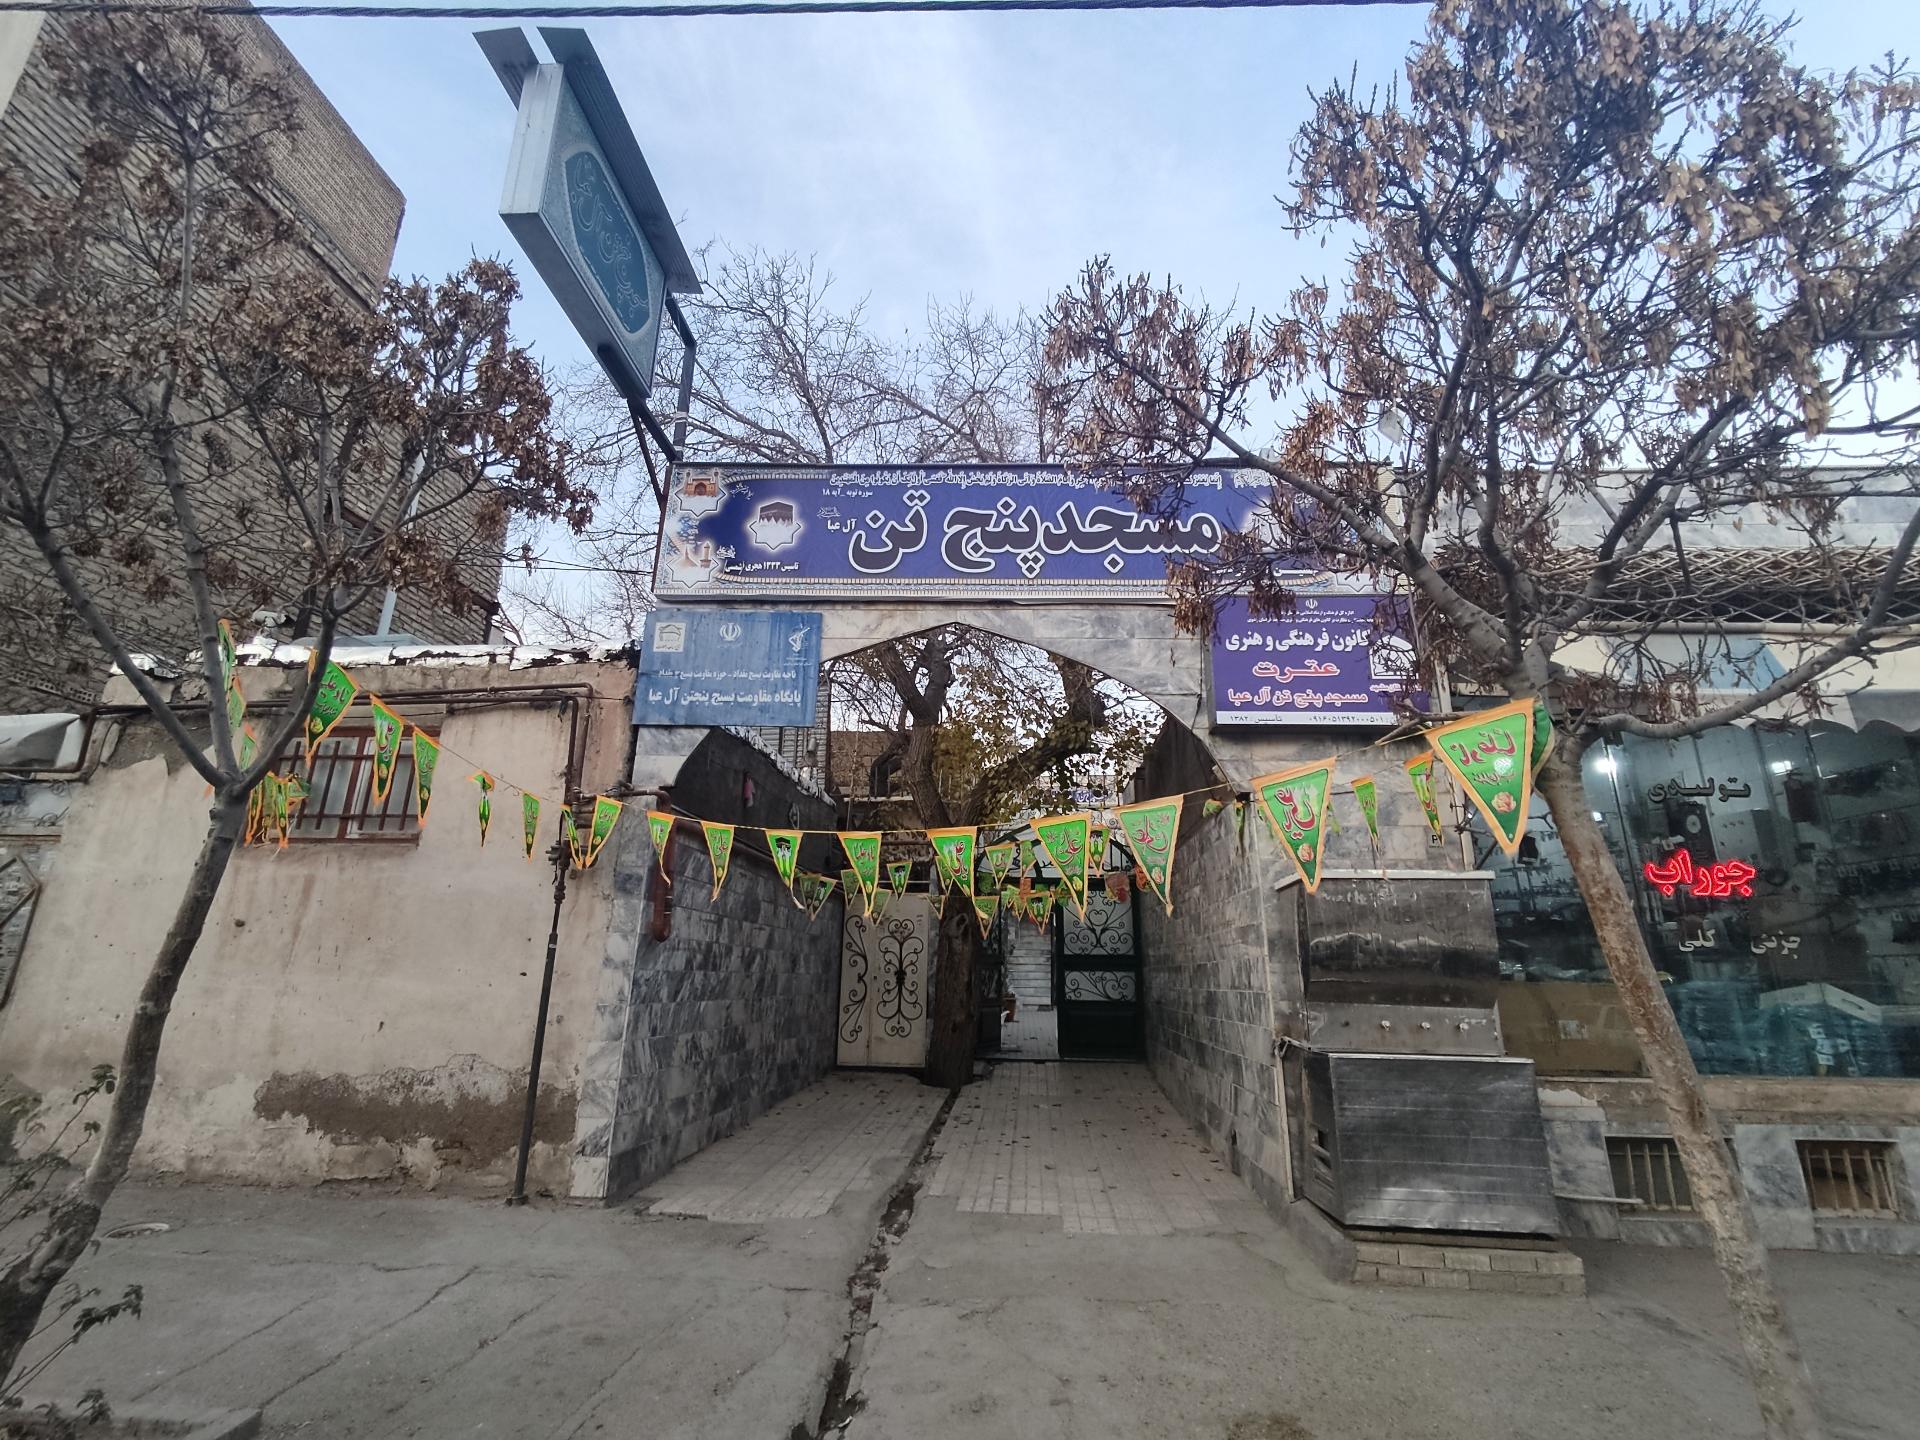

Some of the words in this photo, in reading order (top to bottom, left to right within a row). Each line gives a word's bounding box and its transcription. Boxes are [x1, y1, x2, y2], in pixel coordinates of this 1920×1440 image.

[827, 519, 840, 532] عبا
[842, 518, 857, 533] آل
[849, 489, 932, 574] تن
[940, 496, 1041, 579] پنج
[1040, 501, 1222, 575] مسجد
[1226, 630, 1263, 651] هنری
[1265, 635, 1274, 651] و
[1276, 628, 1330, 652] فرهنگی
[1332, 628, 1371, 651] کانون
[1253, 659, 1340, 683] عترت
[649, 688, 663, 703] عبا
[664, 687, 681, 705] آل
[681, 690, 710, 706] پنجتن
[711, 692, 735, 707] بسیج
[737, 689, 773, 706] مقاومت
[775, 692, 802, 707] پایگاه
[1228, 689, 1252, 707] عبا
[1254, 686, 1272, 706] آل
[1274, 689, 1292, 706] تن
[1294, 691, 1323, 708] پنج
[1324, 692, 1368, 708] مسجد
[1648, 776, 1751, 806] تولیدی
[1644, 848, 1758, 898] جوراب
[1678, 929, 1717, 953] کلی
